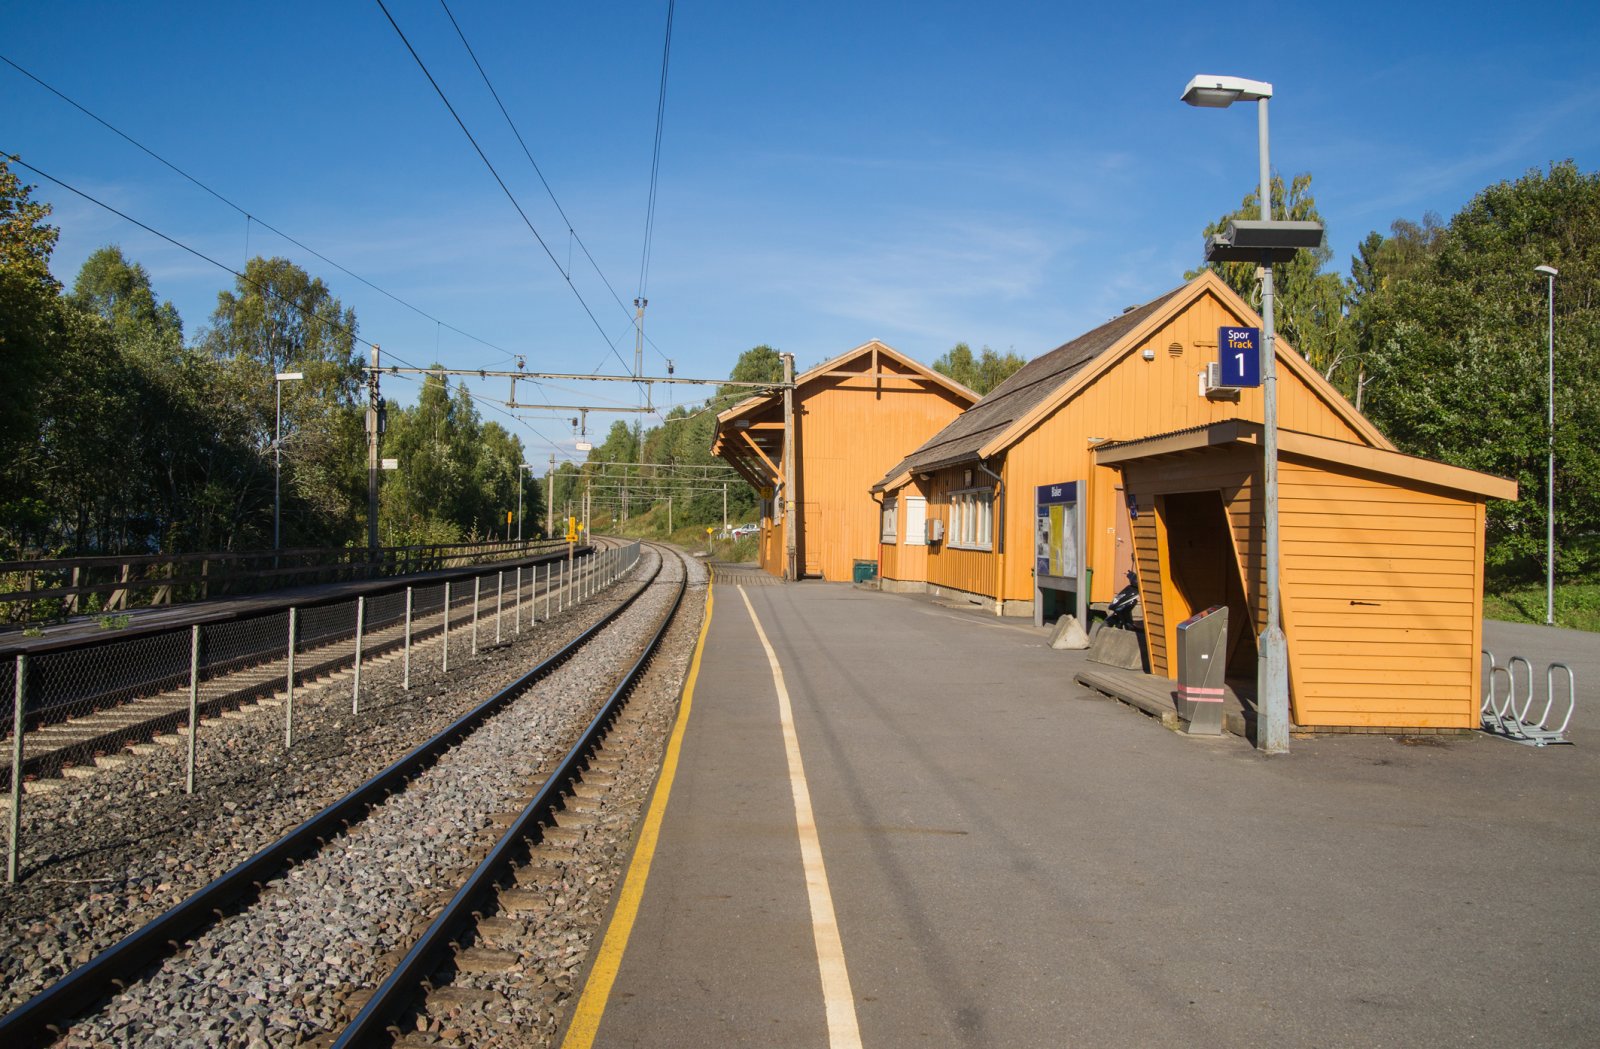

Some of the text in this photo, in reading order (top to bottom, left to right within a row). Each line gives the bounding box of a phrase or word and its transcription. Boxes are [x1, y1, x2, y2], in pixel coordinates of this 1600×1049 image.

[1228, 330, 1249, 340] Spor
[1228, 340, 1253, 349] Track
[1235, 353, 1244, 377] 1
